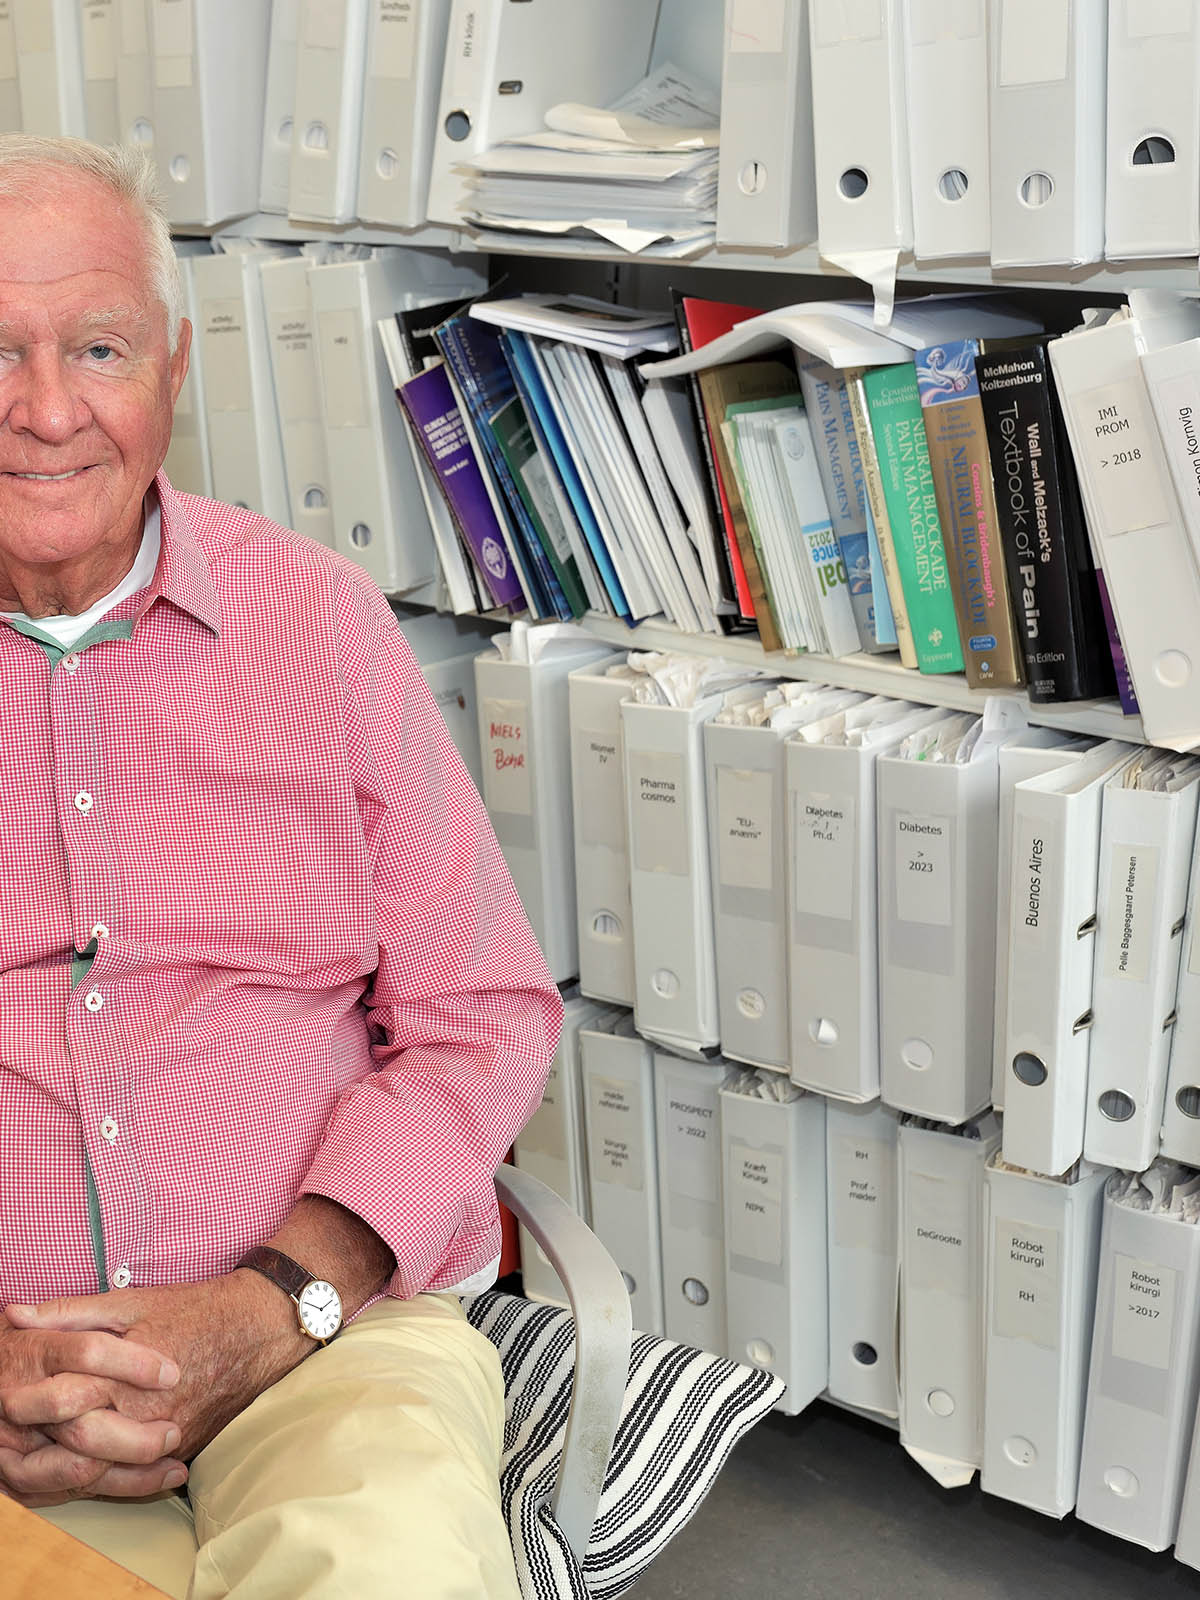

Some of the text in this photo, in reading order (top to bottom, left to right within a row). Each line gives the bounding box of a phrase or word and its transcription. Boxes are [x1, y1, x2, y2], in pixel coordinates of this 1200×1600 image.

[983, 359, 1035, 378] McMahon
[980, 371, 1043, 393] Koltzenburg
[836, 376, 855, 436] NEURAL
[1098, 406, 1119, 420] IMI
[1095, 419, 1130, 437] PROM
[1179, 406, 1200, 457] Kornvig
[815, 382, 852, 521] PAIN MANAGEMENT
[1100, 448, 1142, 468] > 2018
[950, 446, 975, 520] NEURAL
[1027, 423, 1052, 563] Wall and Melzack's
[895, 420, 933, 596] PAIN MANAGEMENT
[911, 417, 947, 591] NEURAL BLOCKADE
[998, 400, 1040, 640] Textbook of Pain
[808, 530, 832, 548] 2012
[971, 463, 984, 507] Cousins
[978, 522, 996, 607] Bridenbaugh's
[1036, 652, 1065, 663] Edition
[640, 776, 676, 792] Pharma
[641, 790, 676, 804] cosmos
[805, 804, 843, 820] Diabetes
[899, 821, 942, 836] Diabetes
[908, 860, 934, 874] 2023
[1125, 856, 1137, 894] Petersen
[1025, 838, 1044, 928] Buenos Aires
[1121, 894, 1134, 950] Baggesgaard
[670, 1101, 712, 1118] PROSPECT
[855, 1151, 868, 1160] RH
[917, 1227, 962, 1247] DeGrootte
[1012, 1237, 1044, 1254] Robot
[1010, 1250, 1045, 1268] kirurgi
[1131, 1270, 1160, 1286] Robot
[1019, 1290, 1035, 1303] RH
[1130, 1281, 1161, 1298] kirurgi
[1129, 1303, 1160, 1320] >2017
